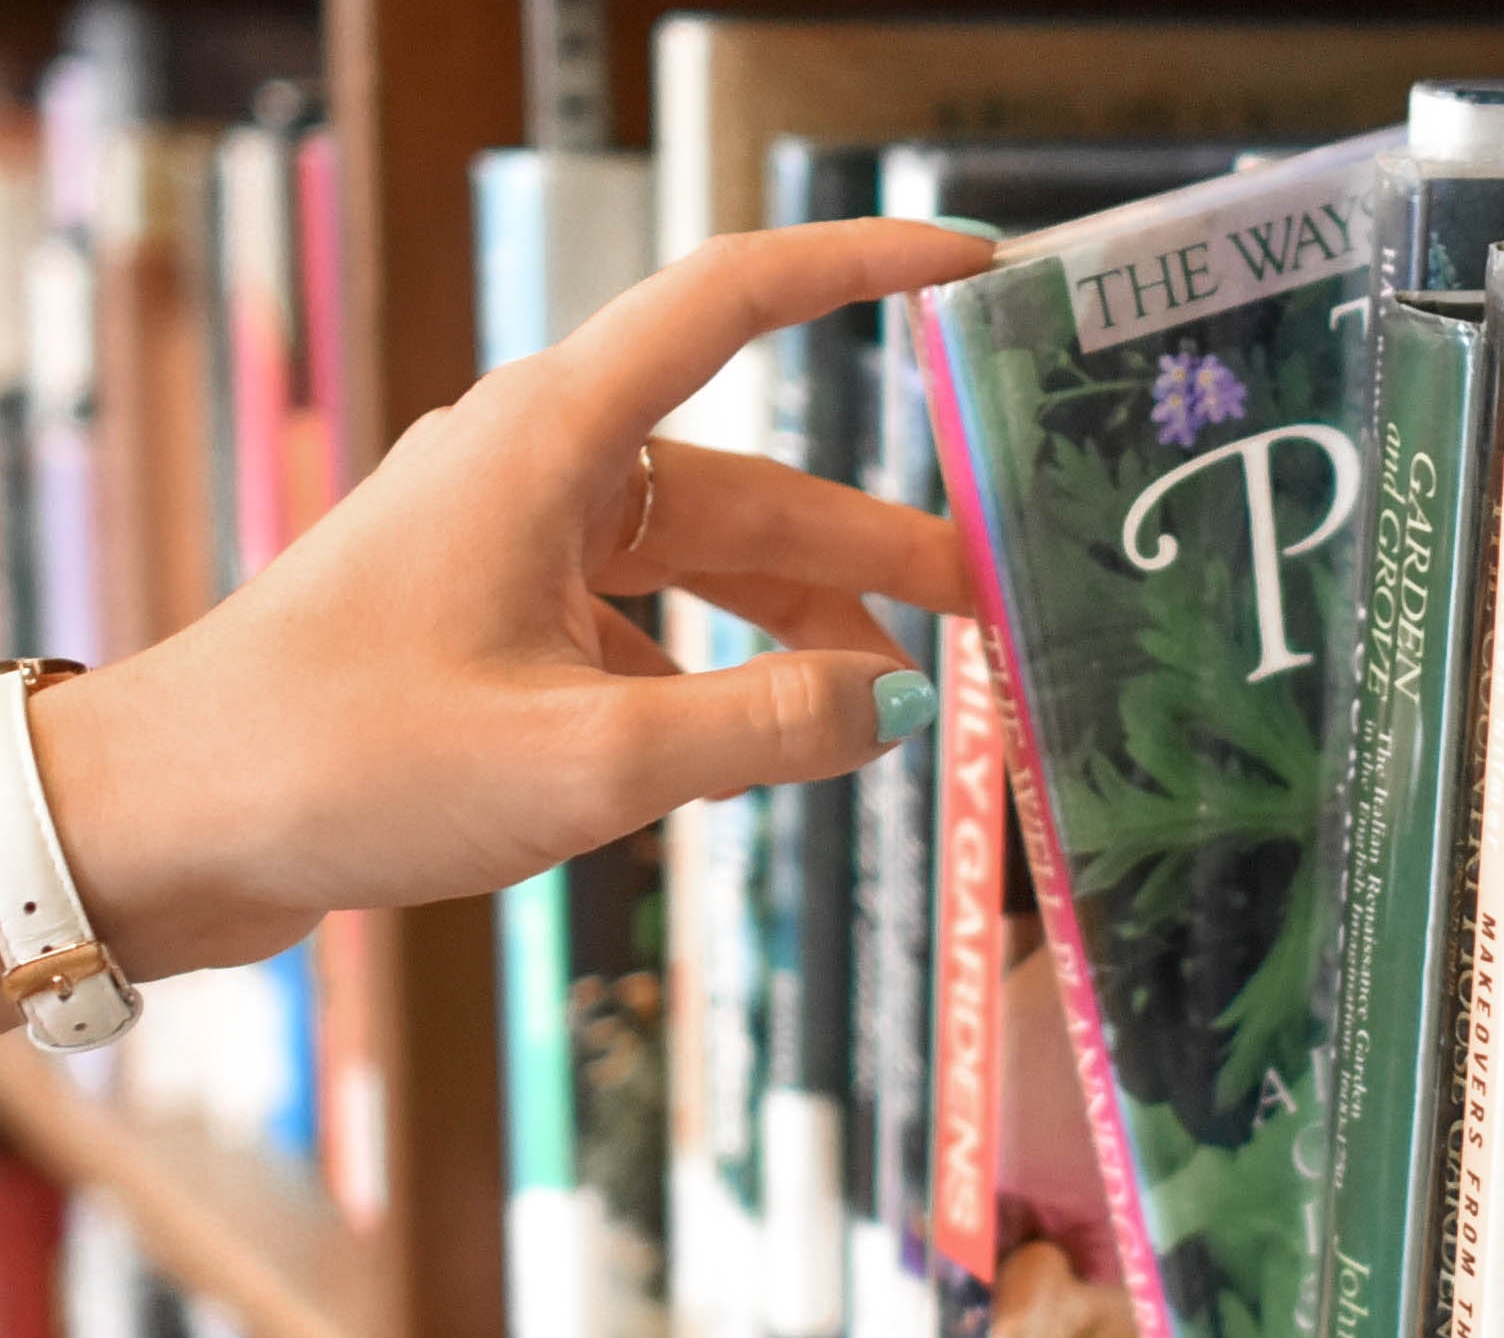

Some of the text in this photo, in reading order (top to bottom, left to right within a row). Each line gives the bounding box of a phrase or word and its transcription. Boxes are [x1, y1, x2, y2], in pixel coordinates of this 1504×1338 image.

[1076, 241, 1219, 331] THE
[1366, 420, 1402, 703] and GROVE
[1394, 450, 1437, 706] GARDEN
[944, 817, 991, 1237] GARDENS
[1350, 729, 1394, 1119] The Italian Renaissance Garden
[1468, 912, 1497, 1150] MAKEOVERS
[1461, 1169, 1481, 1278] FROM
